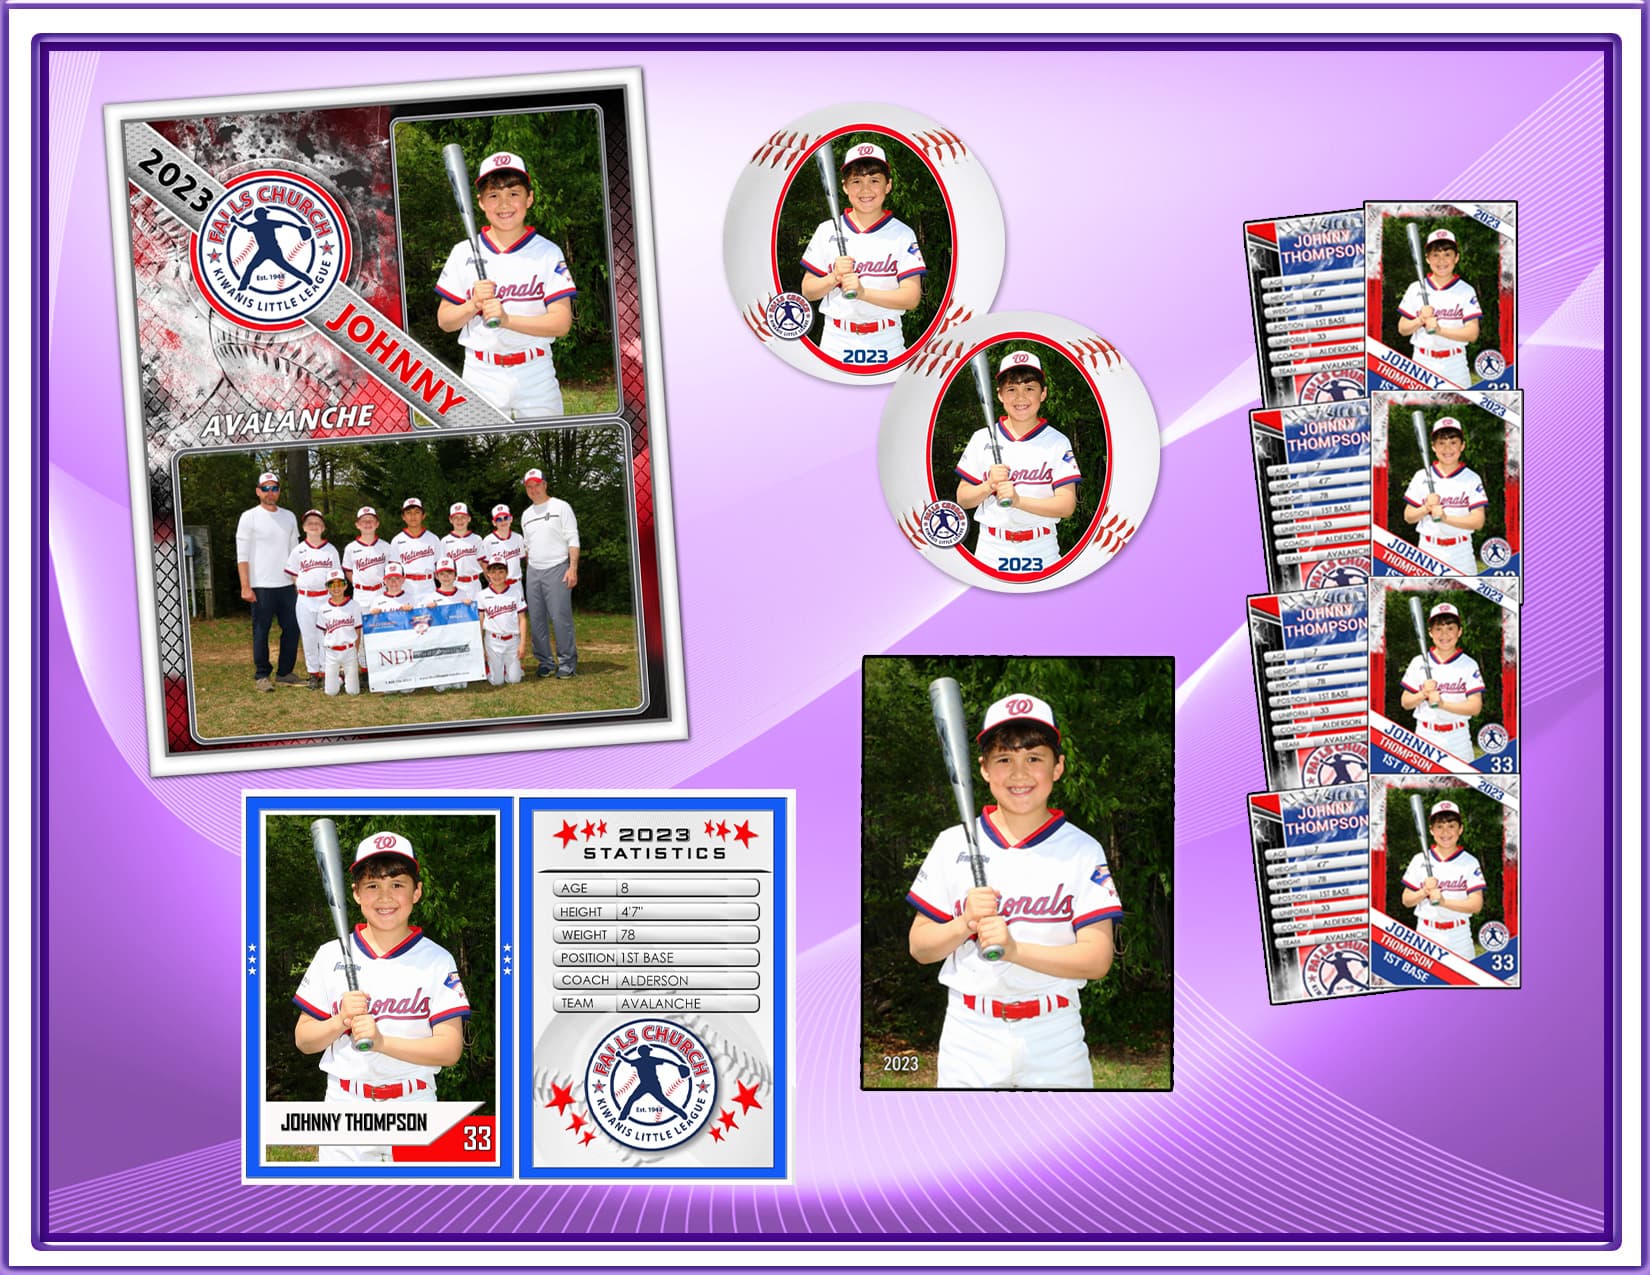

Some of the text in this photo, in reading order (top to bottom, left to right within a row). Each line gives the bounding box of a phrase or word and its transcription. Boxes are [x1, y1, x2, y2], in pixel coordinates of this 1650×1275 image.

[138, 148, 214, 212] 2023
[207, 185, 333, 245] FALLS CHURCH
[1473, 209, 1501, 229] 2023
[1294, 229, 1351, 248] JOHNNY
[1281, 244, 1365, 264] THOMPSON
[213, 260, 331, 312] KIWANIS LITTLE LEAGUE
[324, 302, 469, 417] JOHNNY
[843, 350, 888, 364] 2023
[1320, 345, 1359, 355] ALDERSON
[1321, 360, 1363, 370] AVALANCH
[1381, 351, 1445, 389] JOHNNY
[1479, 397, 1507, 417] 2023
[200, 404, 375, 439] AVALANCHE
[1300, 417, 1357, 436] JOHNNY
[1287, 432, 1371, 452] THOMPSON
[1326, 533, 1365, 543] ALDERSON
[1327, 548, 1369, 558] AVALANCH
[1387, 539, 1451, 576] JOHNNY
[998, 557, 1044, 571] 2023
[1476, 583, 1504, 603] 2023
[1297, 603, 1354, 622] JOHNNY
[1284, 618, 1368, 638] THOMPSON
[379, 648, 414, 666] NDI
[1323, 719, 1362, 729] ALDERSON
[1324, 734, 1366, 744] AVALANCH
[1384, 725, 1448, 763] JOHNNY
[1380, 736, 1432, 772] THOMPSON
[1382, 753, 1401, 769] 1ST
[1491, 757, 1513, 773] 33
[1477, 780, 1505, 800] 2023
[1298, 801, 1355, 820] JOHNNY
[619, 828, 690, 842] 2023
[1285, 816, 1369, 836] THOMPSON
[583, 847, 727, 860] STATISTICS
[561, 882, 629, 894] AGE 8
[560, 906, 643, 917] HEIGHT 4'7"
[1324, 917, 1363, 927] ALDERSON
[562, 929, 636, 940] WEIGHT 78
[1325, 932, 1367, 942] AVALANCH
[1385, 922, 1449, 960] JOHNNY
[561, 952, 674, 963] POSITION 1ST BASE
[1380, 934, 1434, 970] THOMPSON
[1383, 951, 1430, 983] 1ST BASE
[1492, 954, 1514, 971] 33
[562, 975, 689, 986] COACH ALDERSON
[562, 998, 701, 1009] TEAM AVALANCHE
[593, 1025, 710, 1078] FALLS CHURCH
[281, 1113, 428, 1131] JOHNNY THOMPSON
[597, 1098, 706, 1142] KIWANIS LITTLE LEAGUE
[463, 1125, 491, 1151] 33
